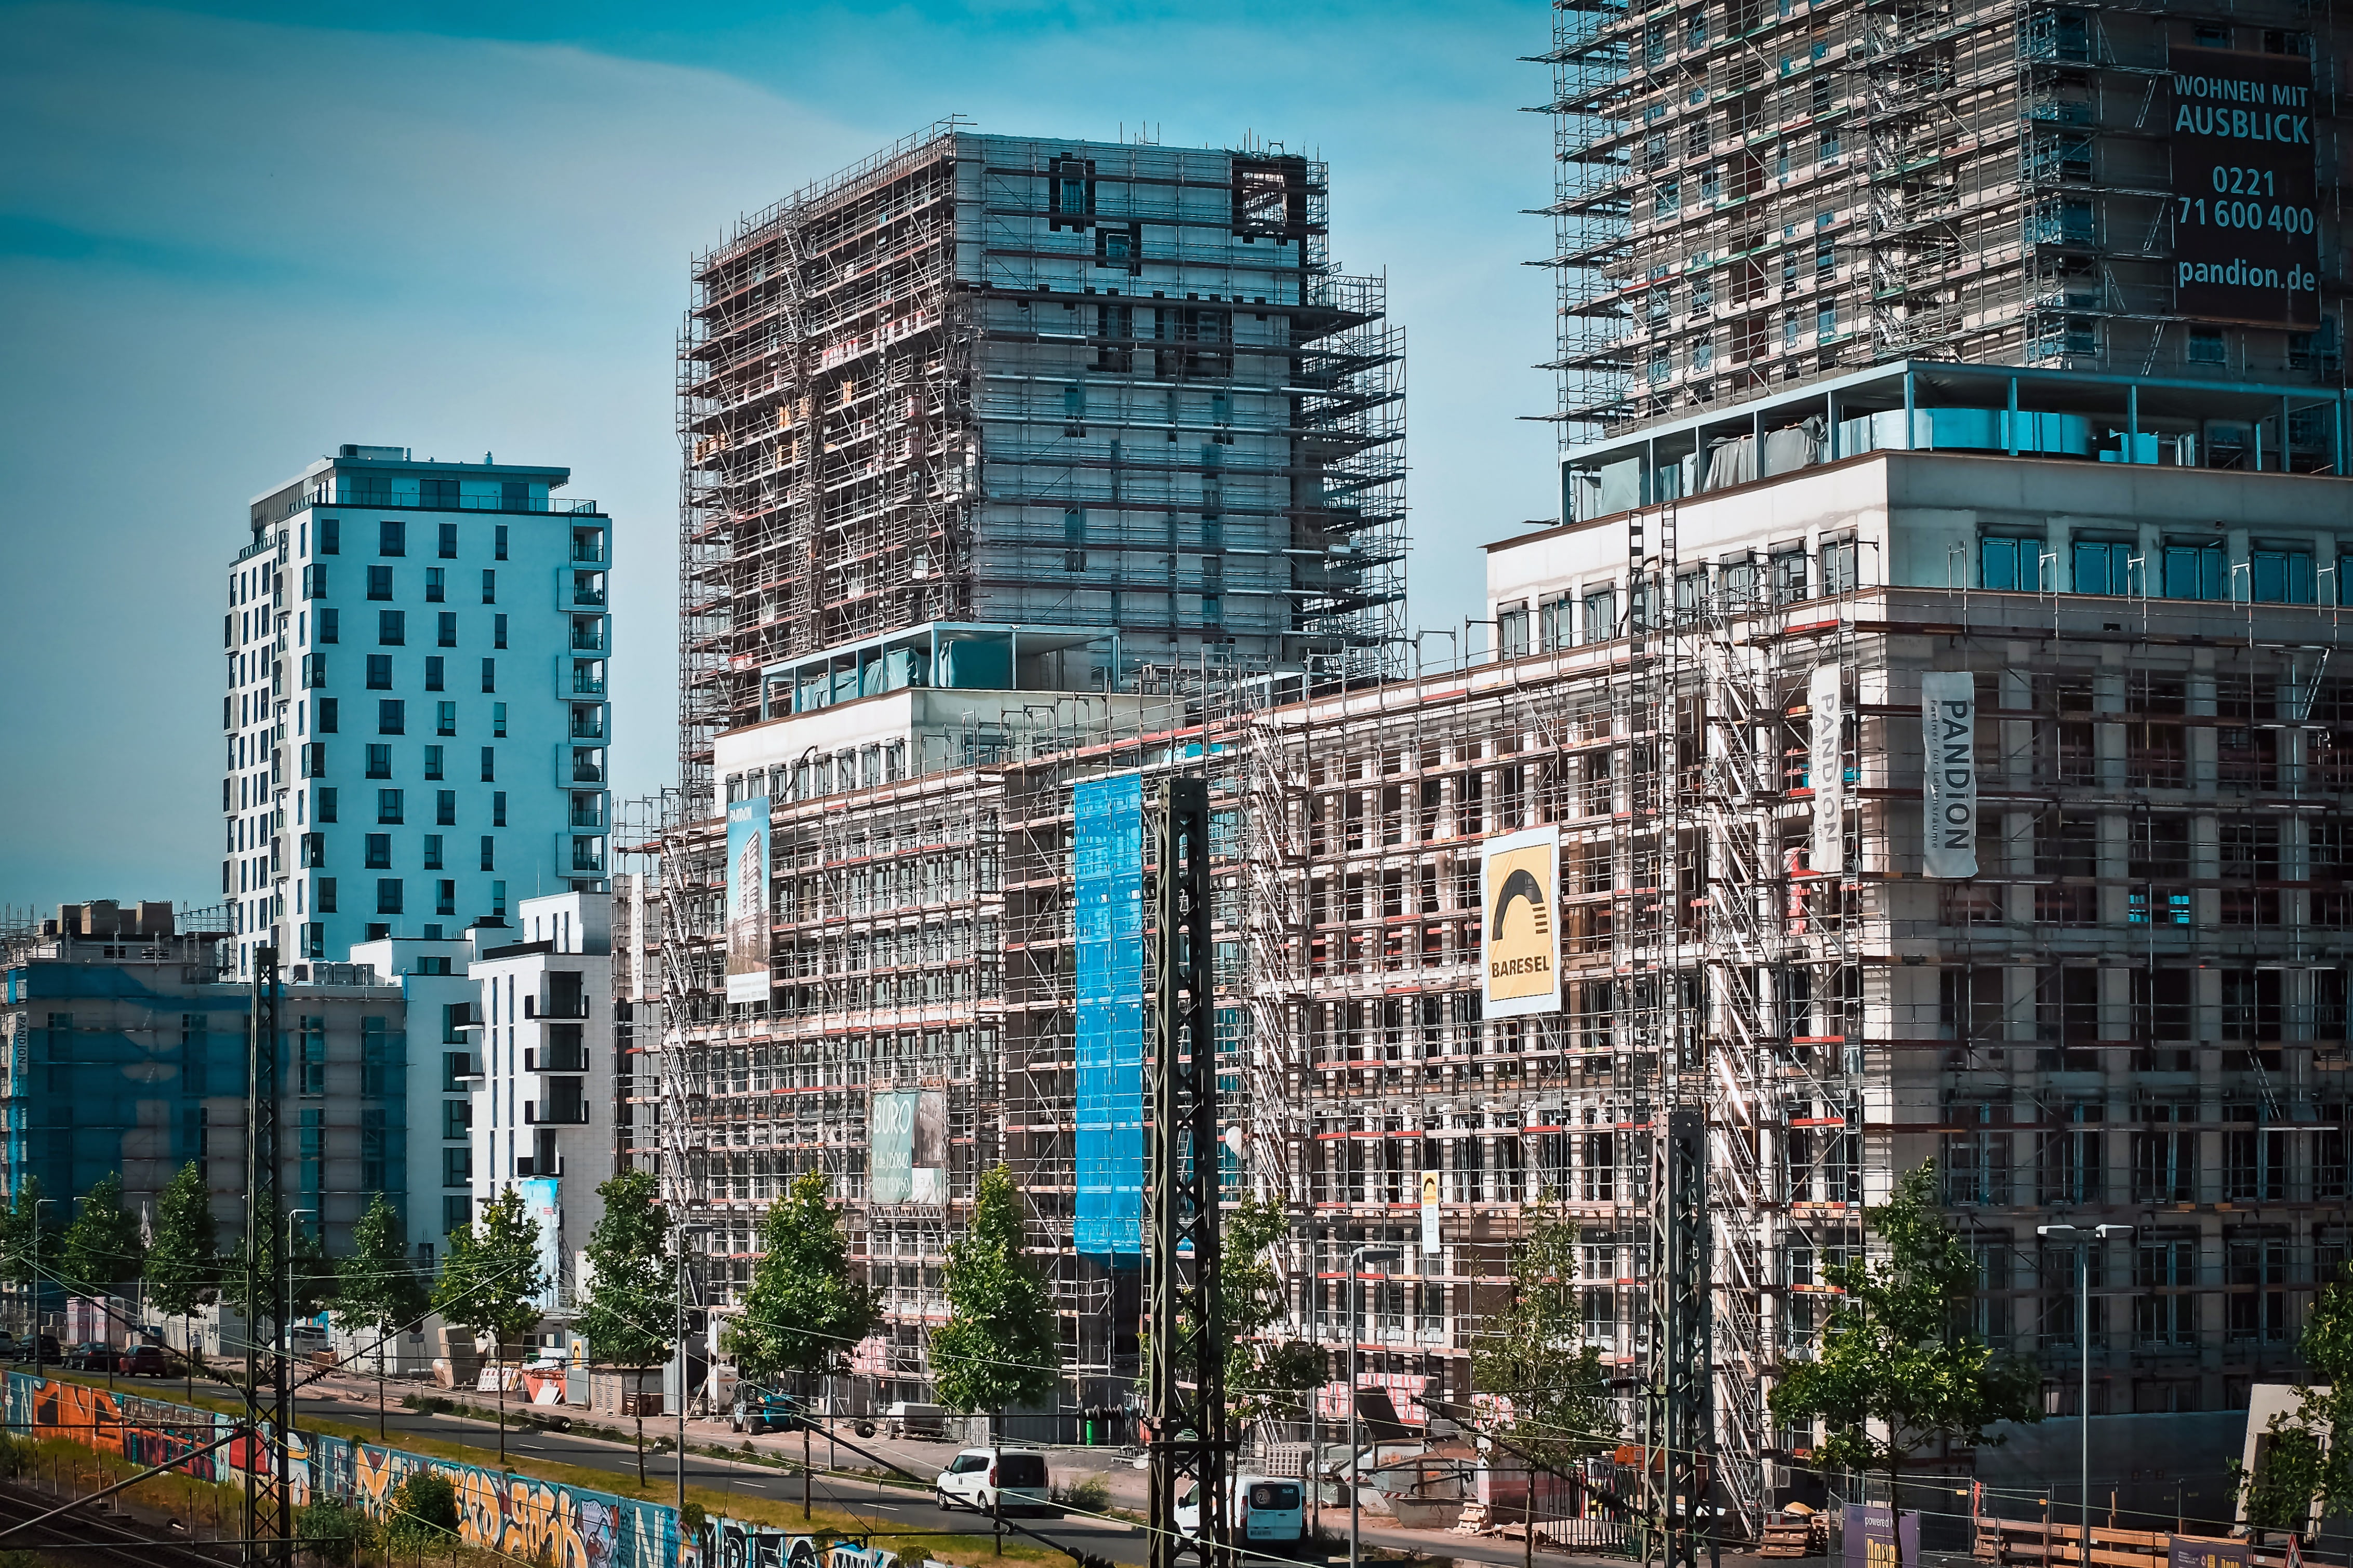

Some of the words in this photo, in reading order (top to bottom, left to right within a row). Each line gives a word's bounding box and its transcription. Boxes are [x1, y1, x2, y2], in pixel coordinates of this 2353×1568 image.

[2174, 75, 2265, 103] WOHNEN
[2272, 84, 2308, 107] MIT
[2176, 104, 2310, 144] AUSBLICK
[2213, 166, 2274, 197] 0221
[2178, 197, 2205, 225] 71
[2214, 200, 2263, 230] 600
[2267, 205, 2314, 235] 400
[2179, 258, 2315, 291] pandion.de
[1930, 700, 1938, 743] Partner
[1492, 955, 1550, 978] BARESEL
[17, 1017, 26, 1063] PANDION
[873, 1096, 911, 1134] BÜRO
[1865, 1517, 1889, 1527] powered
